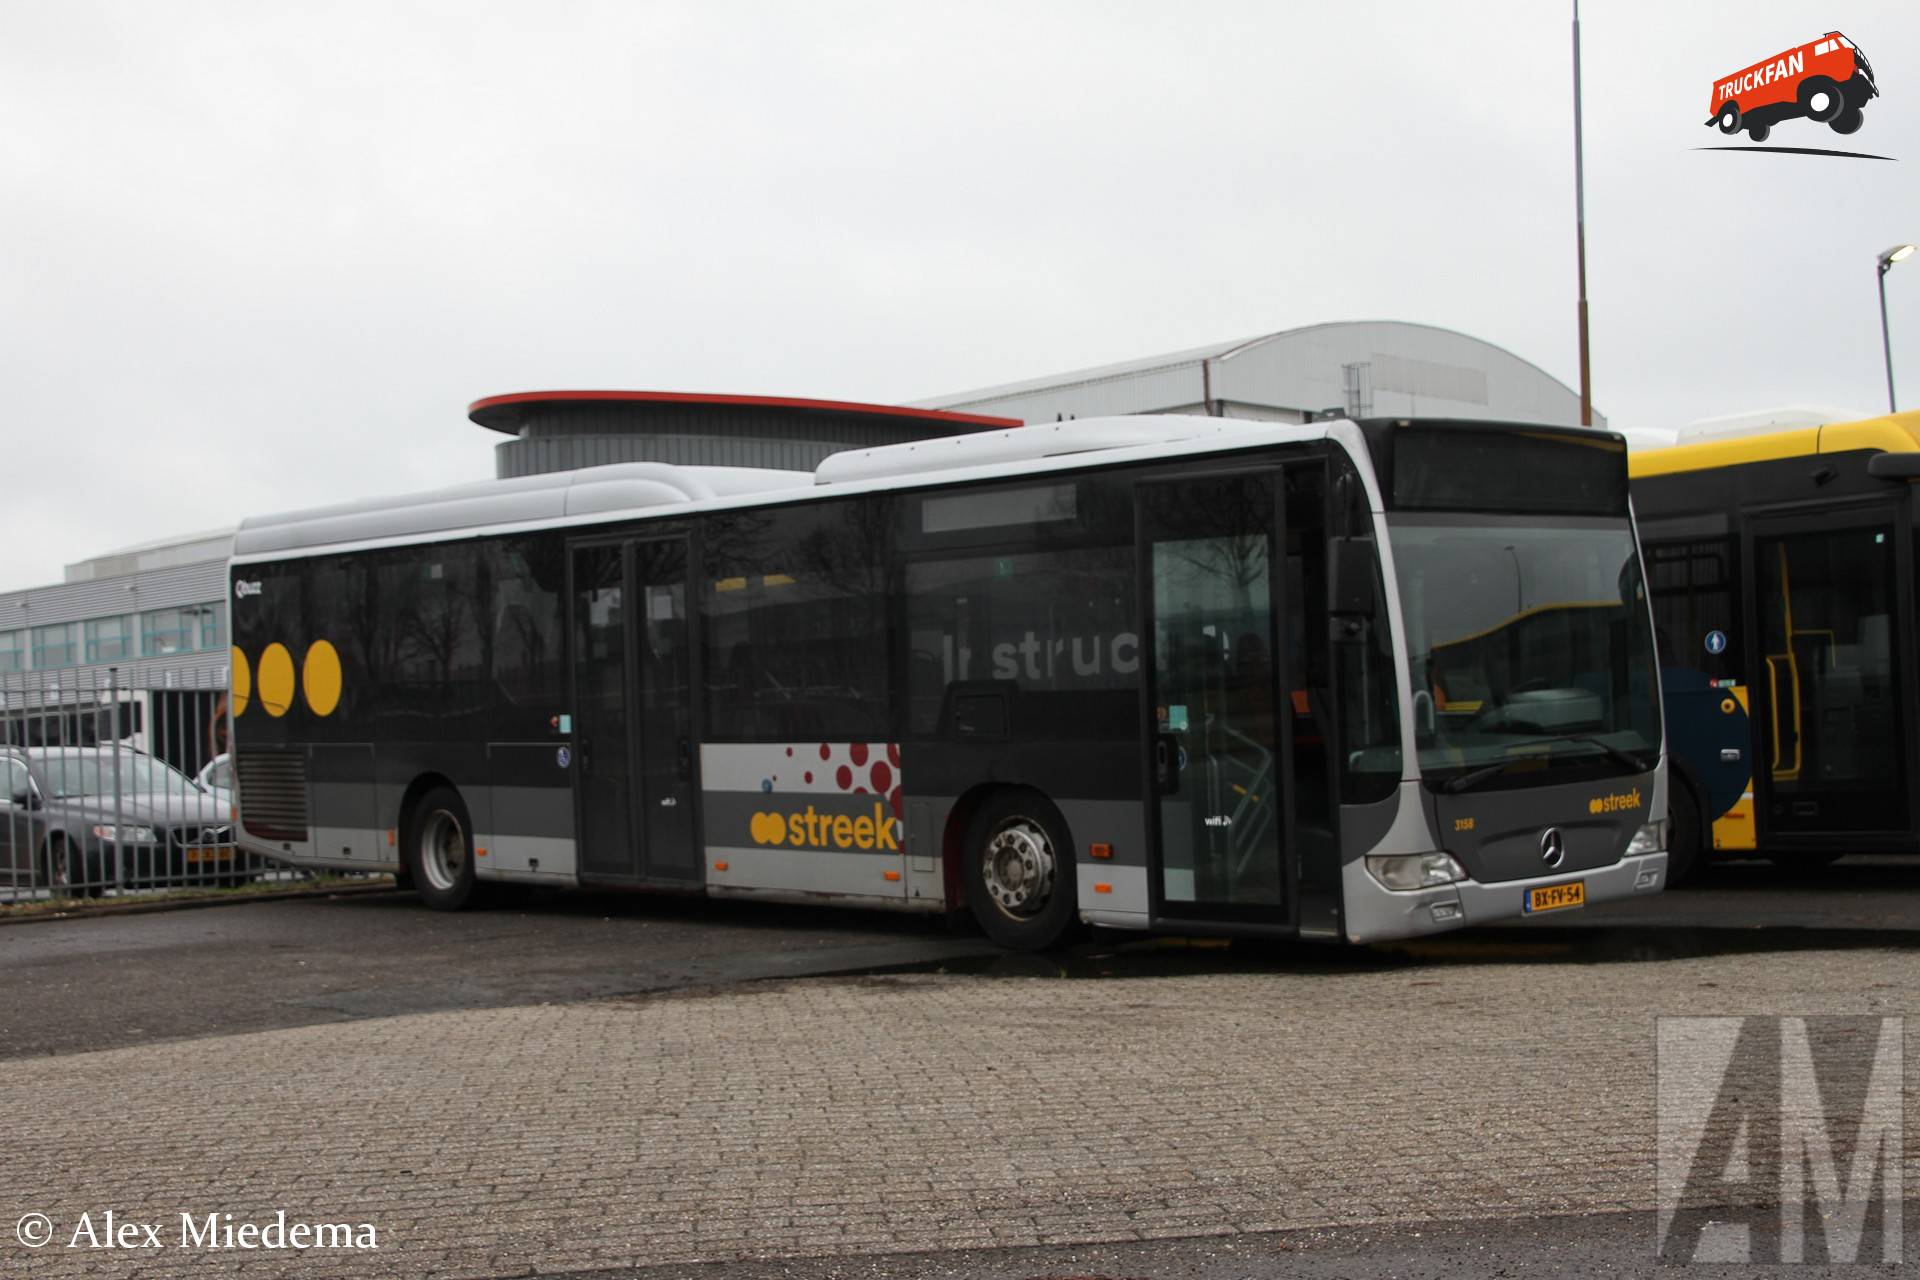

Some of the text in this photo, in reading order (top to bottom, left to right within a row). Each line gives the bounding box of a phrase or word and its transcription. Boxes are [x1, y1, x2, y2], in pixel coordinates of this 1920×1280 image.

[1603, 789, 1641, 812] streek
[788, 802, 898, 850] streek
[1534, 886, 1580, 908] BX-FV-54
